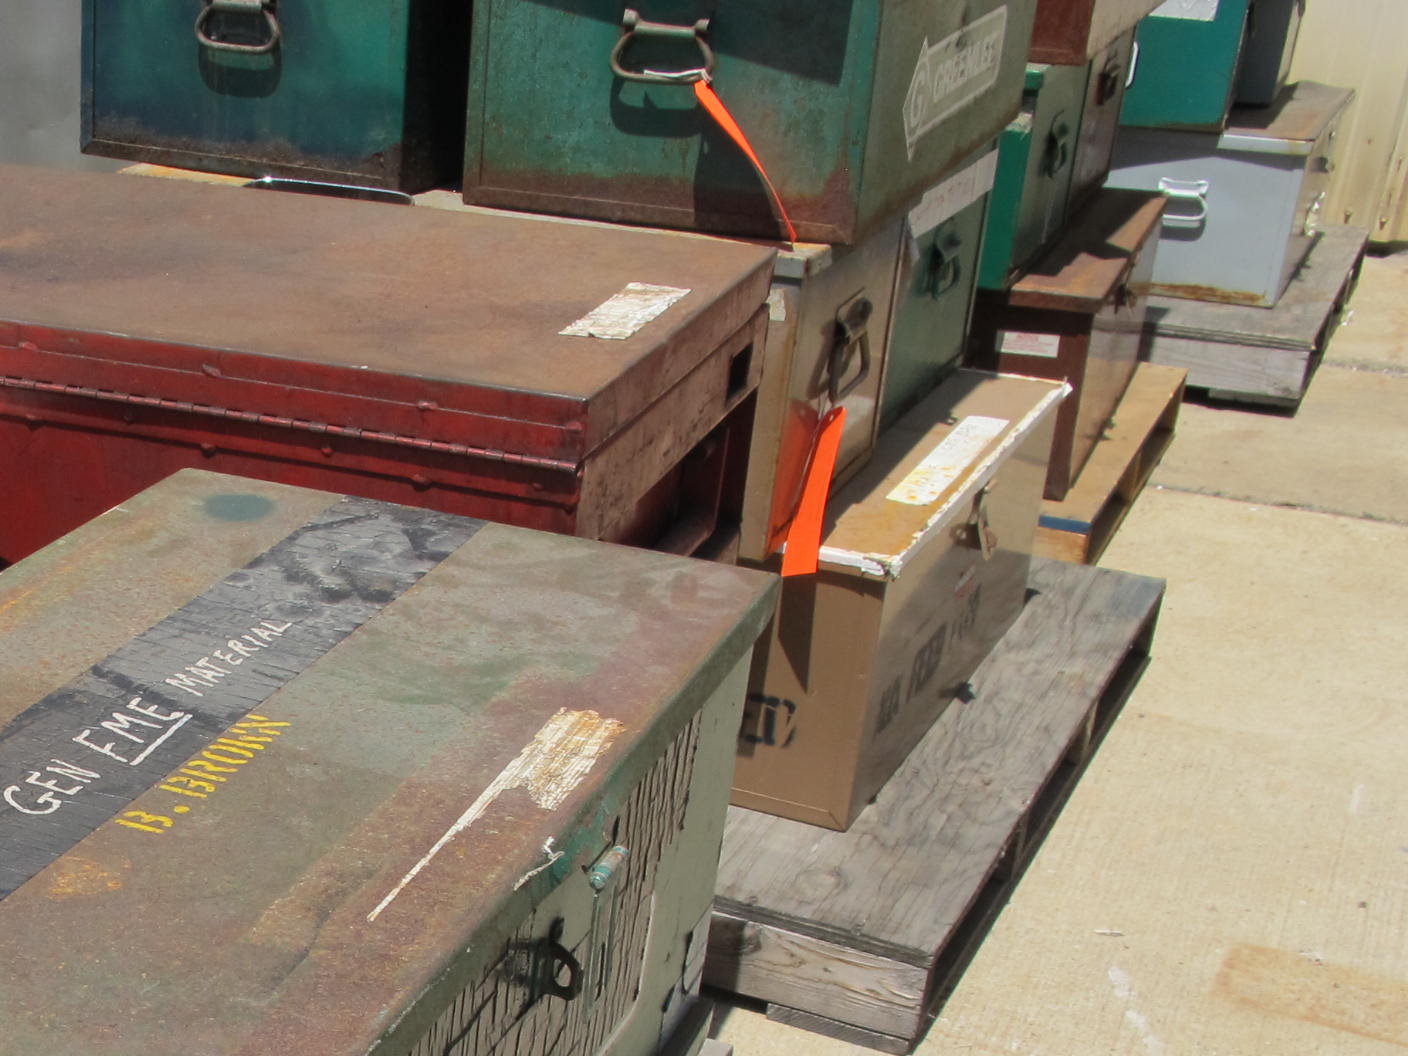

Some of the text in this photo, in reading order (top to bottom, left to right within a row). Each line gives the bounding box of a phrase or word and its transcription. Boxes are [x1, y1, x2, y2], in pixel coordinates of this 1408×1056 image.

[3, 617, 293, 815] GEN FME MATERIAL
[158, 714, 290, 800] BROWN
